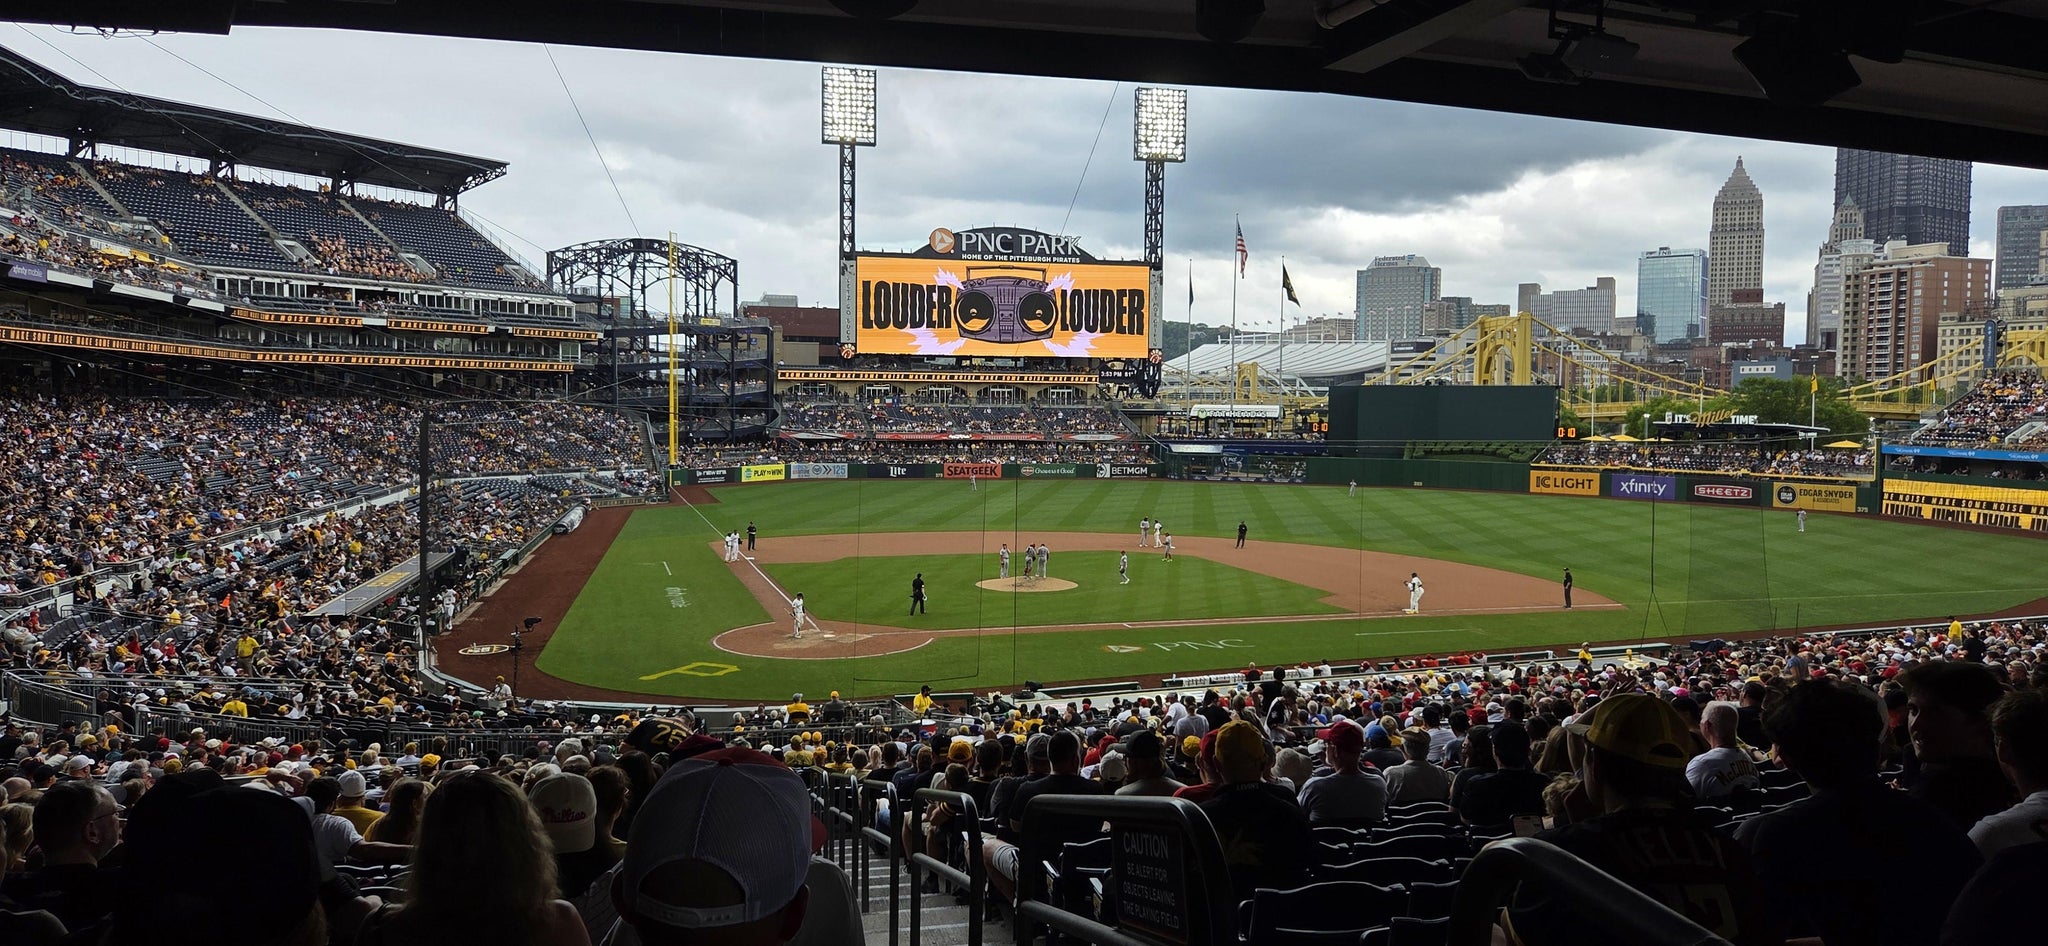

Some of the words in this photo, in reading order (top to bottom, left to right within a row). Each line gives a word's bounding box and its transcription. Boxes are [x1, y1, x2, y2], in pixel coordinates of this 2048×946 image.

[960, 232, 1013, 253] PNC
[1019, 234, 1082, 256] PARK
[1009, 255, 1052, 263] PITTSBURGH
[862, 280, 953, 330] LOUDER
[1060, 288, 1146, 336] LOUDER
[280, 314, 308, 323] NOISE
[316, 316, 339, 324] MAKE
[400, 321, 422, 329] MAKE
[10, 330, 29, 340] MAKE
[32, 332, 51, 342] SOME
[257, 353, 283, 361] MAKE
[288, 354, 313, 362] SOME
[318, 355, 345, 363] NOISE
[405, 358, 430, 366] NOISE
[1691, 408, 1740, 428] Miller
[754, 469, 766, 477] PLAY
[833, 465, 847, 475] 125
[890, 466, 907, 477] Lite
[947, 465, 998, 477] SEATGEEK
[1112, 466, 1148, 475] BETMGM
[1535, 475, 1551, 488] IC
[1553, 478, 1594, 490] LIGHT
[1619, 478, 1667, 496] xfinity
[1698, 486, 1749, 497] SHEETZ
[1799, 488, 1824, 497] EDGAR
[1824, 490, 1854, 499] SNYDER
[1899, 494, 1926, 504] NOISE
[1931, 497, 1956, 506] MAKE
[1961, 500, 1987, 510] SOME
[1992, 504, 2024, 513] NOISE
[1153, 638, 1256, 652] PNC
[542, 806, 586, 824] Phillies
[1123, 831, 1169, 860] CAUTION
[1127, 862, 1135, 876] BE
[1136, 863, 1154, 879] ALERT
[1154, 867, 1168, 884] FOR
[1122, 880, 1149, 899] OBJECTS
[1149, 887, 1176, 907] LEAVING
[1122, 900, 1135, 916] THE
[1135, 903, 1160, 923] PLAYING
[1160, 911, 1180, 929] FIELD
